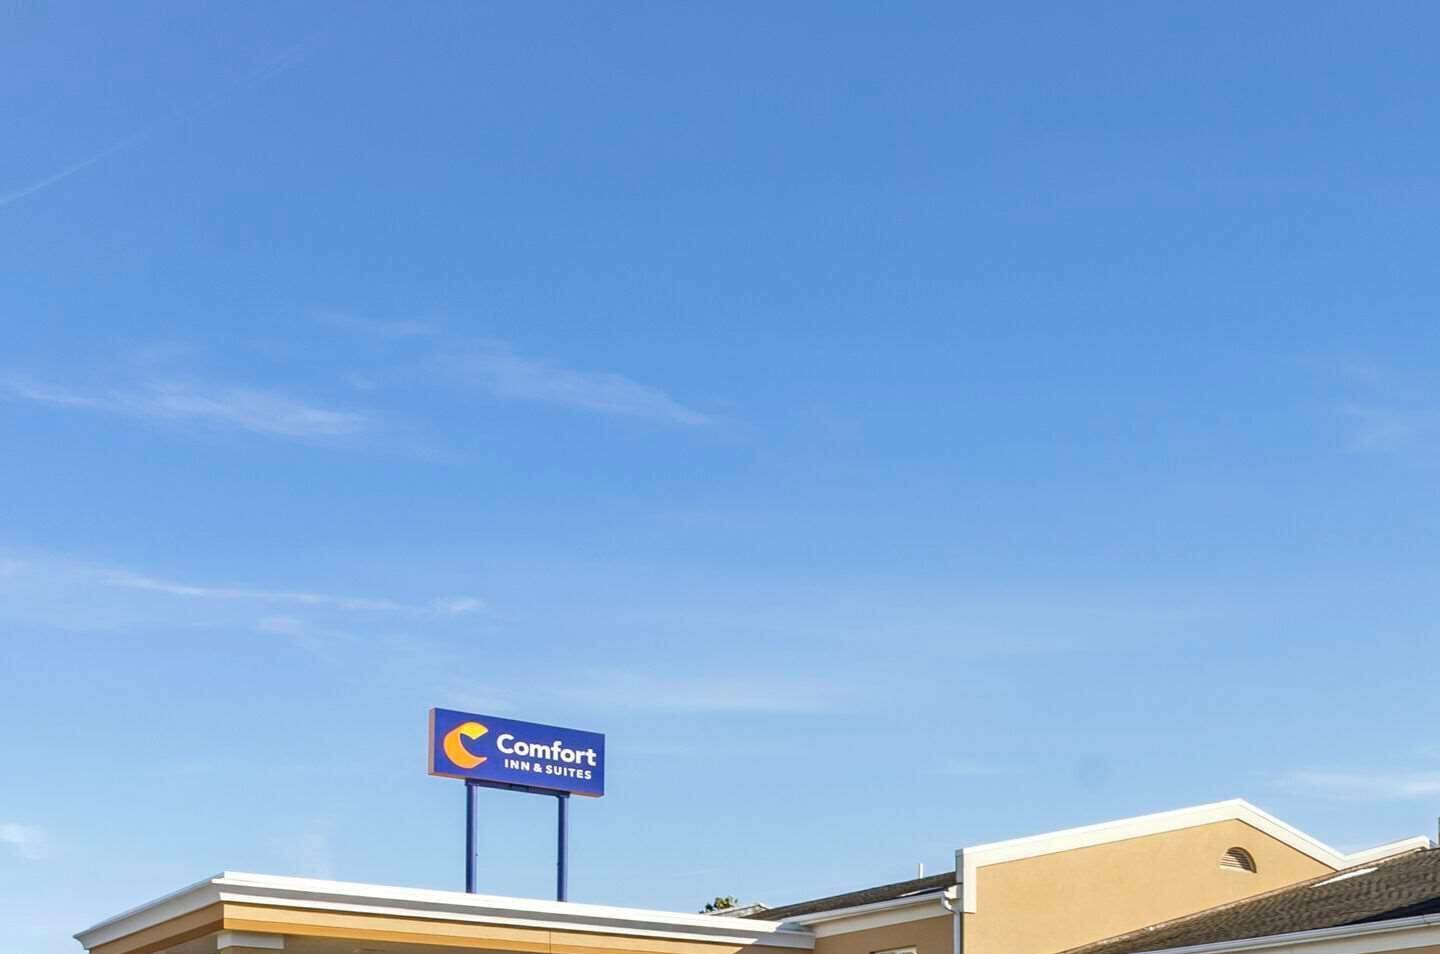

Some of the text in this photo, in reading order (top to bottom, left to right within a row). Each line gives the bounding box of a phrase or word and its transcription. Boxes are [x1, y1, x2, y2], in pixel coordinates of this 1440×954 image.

[496, 734, 597, 766] Comfort
[504, 758, 592, 780] INN & SUITES
